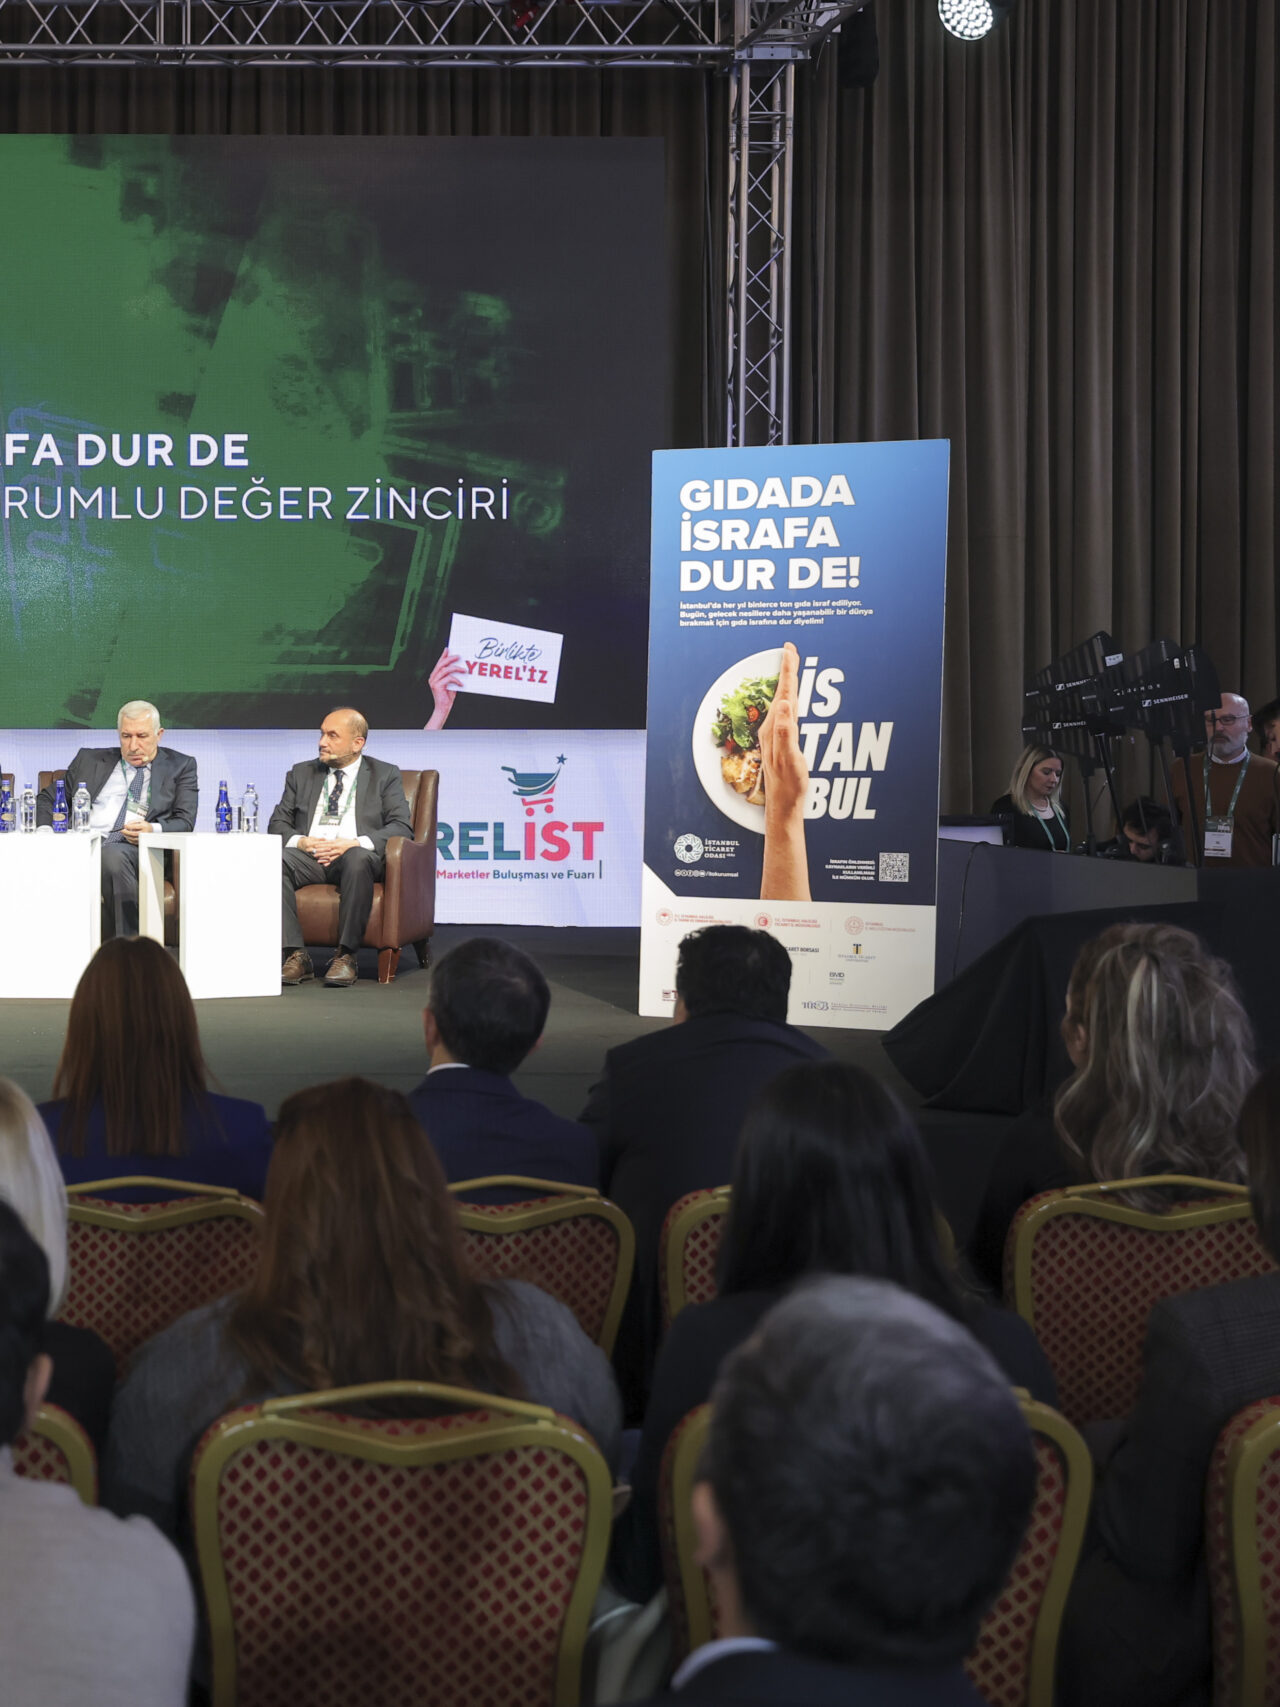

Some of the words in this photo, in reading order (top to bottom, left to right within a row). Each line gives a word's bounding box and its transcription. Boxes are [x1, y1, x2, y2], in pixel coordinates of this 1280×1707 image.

[76, 433, 174, 467] DUR
[189, 433, 249, 467] DE
[180, 476, 333, 520] DEĞER
[345, 478, 509, 520] ZİNCİRİ
[679, 474, 856, 512] GIDADA
[680, 511, 841, 552] İSRAFA
[679, 558, 776, 592] DUR
[787, 556, 861, 590] DE!
[708, 610, 738, 619] gelecek
[836, 608, 847, 616] bir
[849, 608, 874, 617] dünya
[748, 601, 778, 609] binlerce
[475, 637, 542, 664] Birlikte
[799, 721, 894, 772] TAN
[803, 777, 876, 820] BUL
[704, 838, 740, 846] İSTANBUL
[436, 870, 490, 880] Marketler
[492, 869, 549, 881] Buluşması
[567, 869, 595, 879] Fuarı
